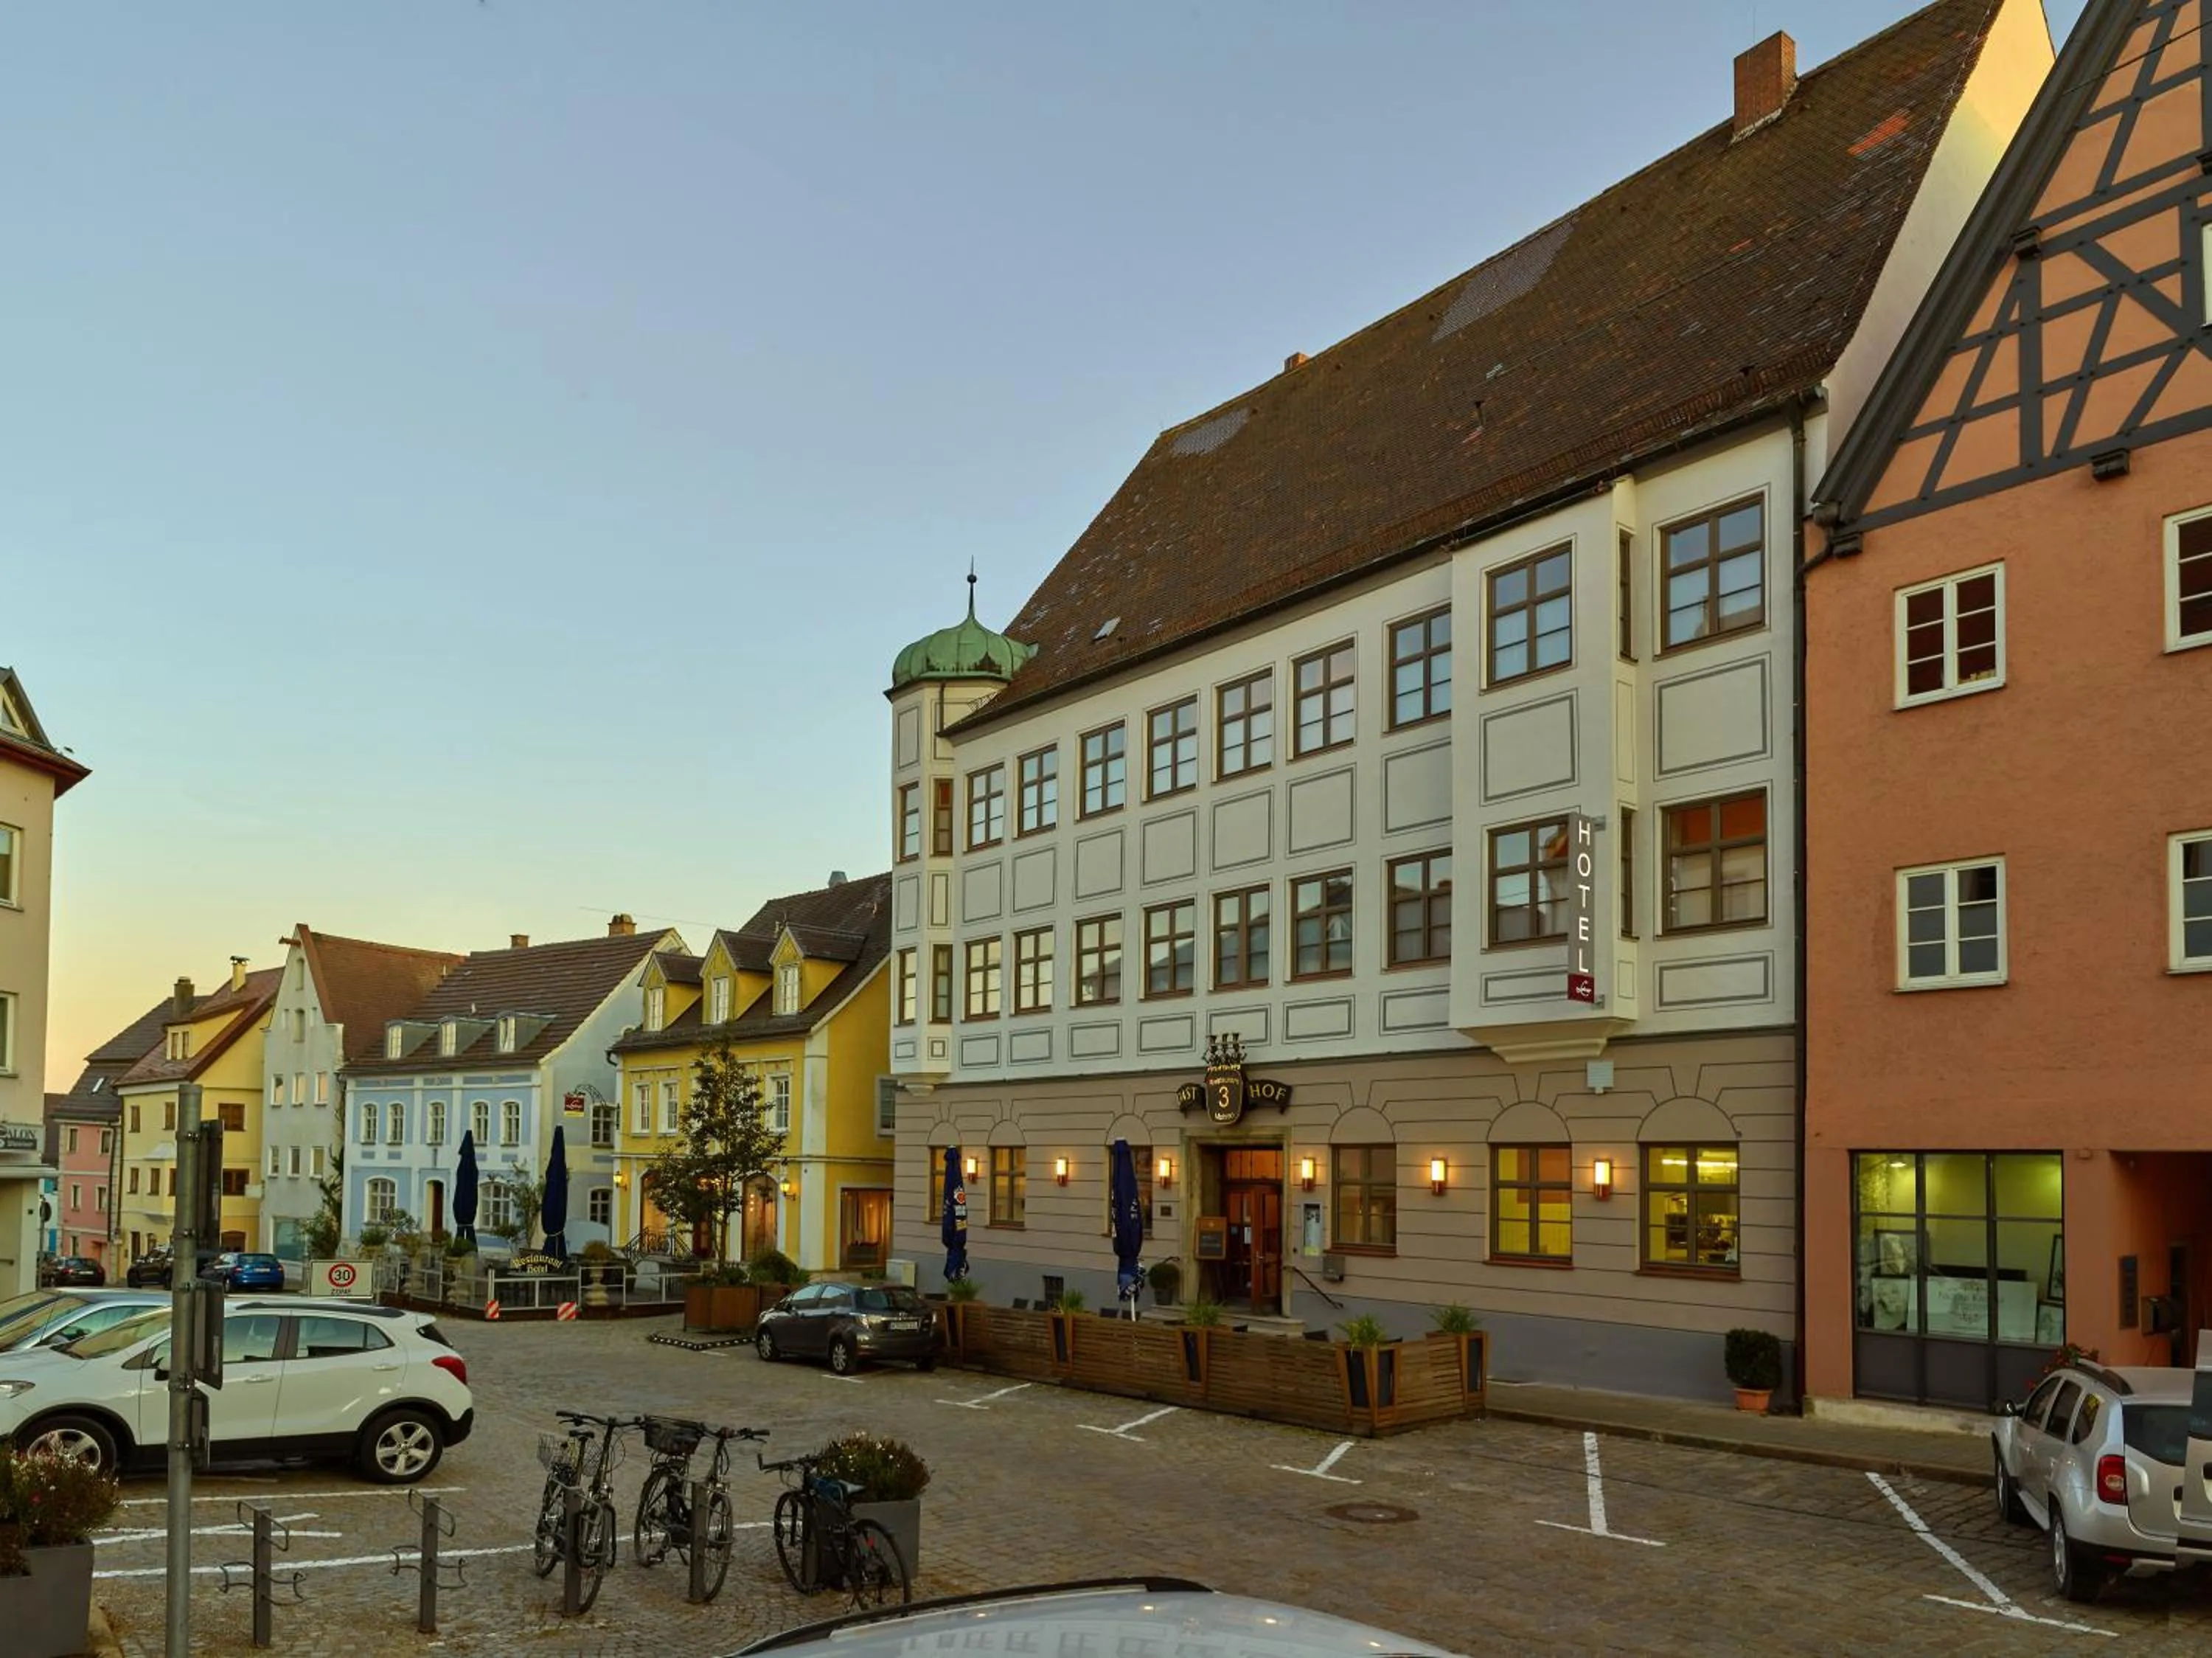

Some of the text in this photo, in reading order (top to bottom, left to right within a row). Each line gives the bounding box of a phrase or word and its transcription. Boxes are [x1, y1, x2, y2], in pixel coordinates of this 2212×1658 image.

[1577, 819, 1591, 974] HOTEL
[1218, 1085, 1230, 1108] 3
[1249, 1083, 1287, 1101] HOF
[334, 1269, 350, 1281] 30
